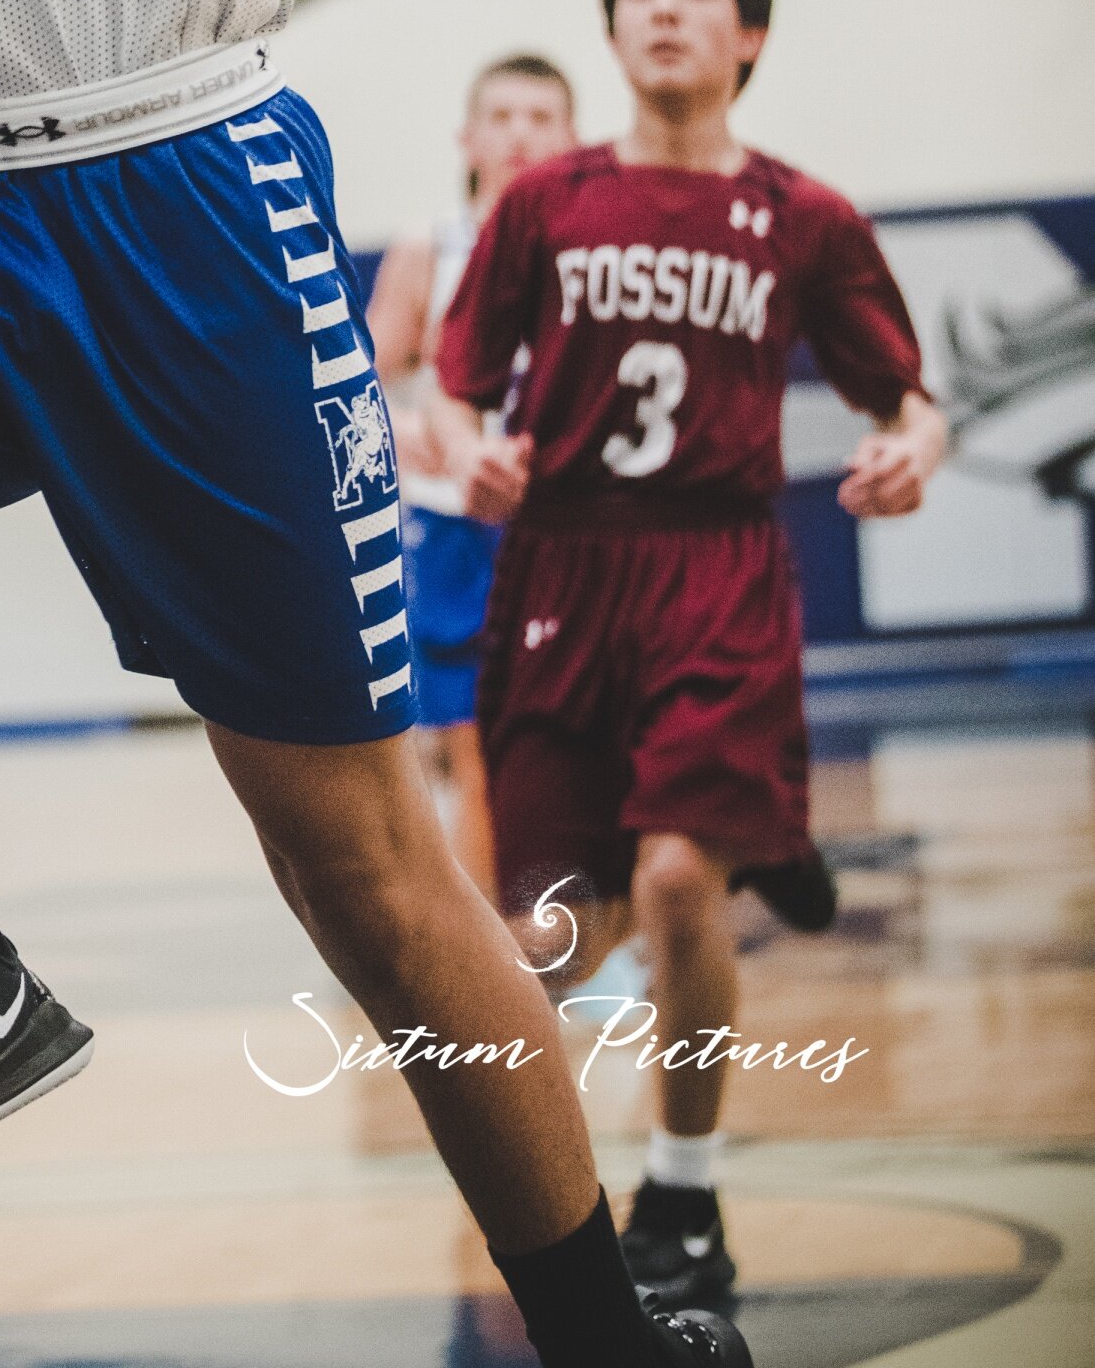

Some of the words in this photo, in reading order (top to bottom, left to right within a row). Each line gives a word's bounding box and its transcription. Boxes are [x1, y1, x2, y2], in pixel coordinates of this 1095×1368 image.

[73, 89, 182, 132] ARMOUR
[191, 60, 254, 100] UNDER
[557, 244, 777, 342] FOSSUM
[601, 340, 688, 477] 3
